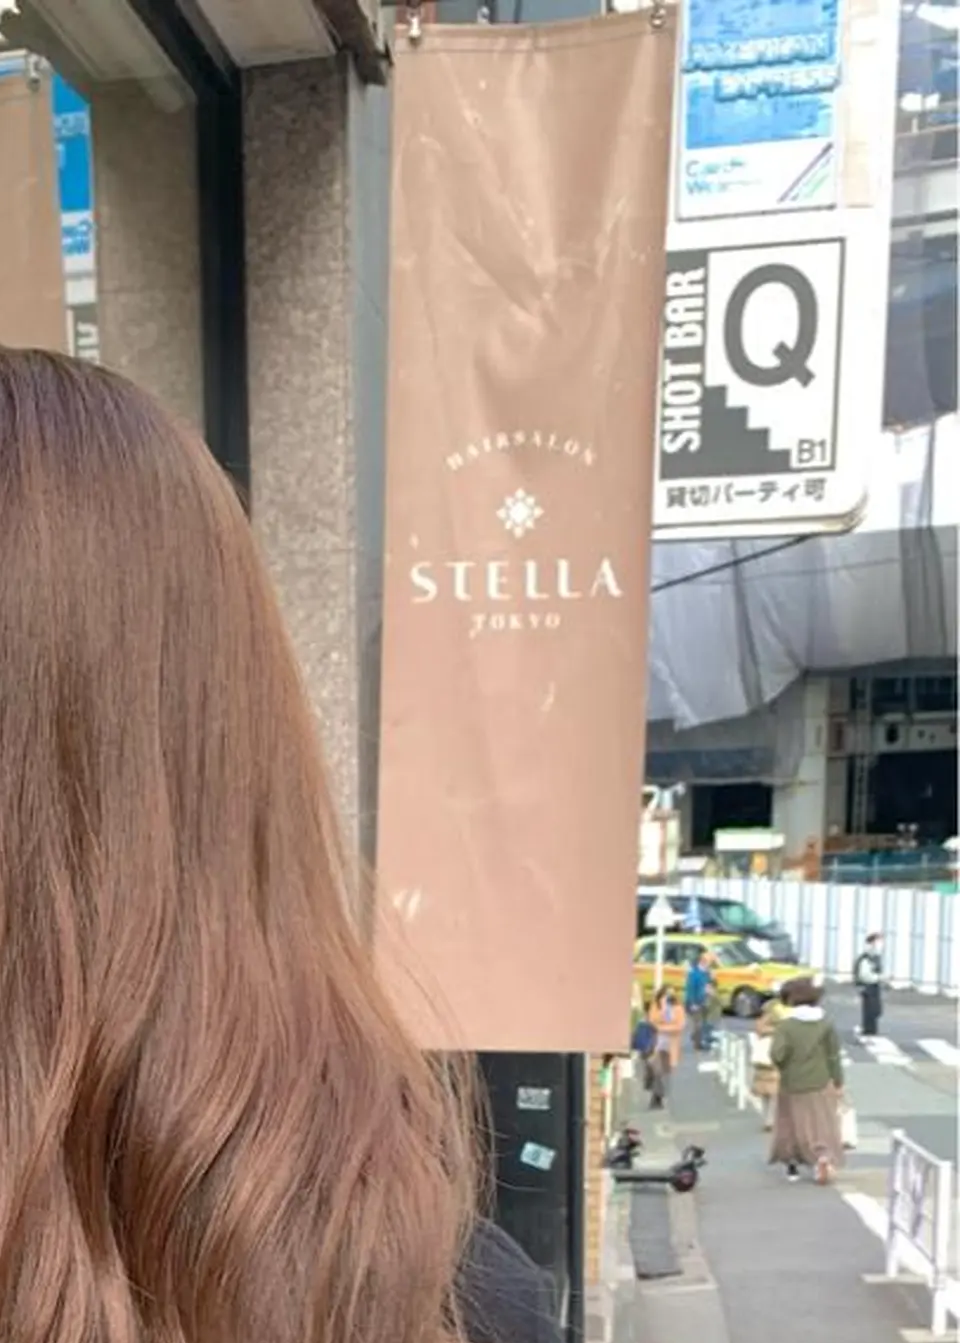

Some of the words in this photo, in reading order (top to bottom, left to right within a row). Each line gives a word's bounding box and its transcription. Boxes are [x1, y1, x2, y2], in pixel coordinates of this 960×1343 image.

[665, 267, 705, 349] BAR
[723, 263, 818, 389] Q
[662, 359, 703, 454] SHOT
[798, 439, 828, 463] B1
[409, 557, 624, 604] STELLA
[470, 612, 561, 631] TOKYO
